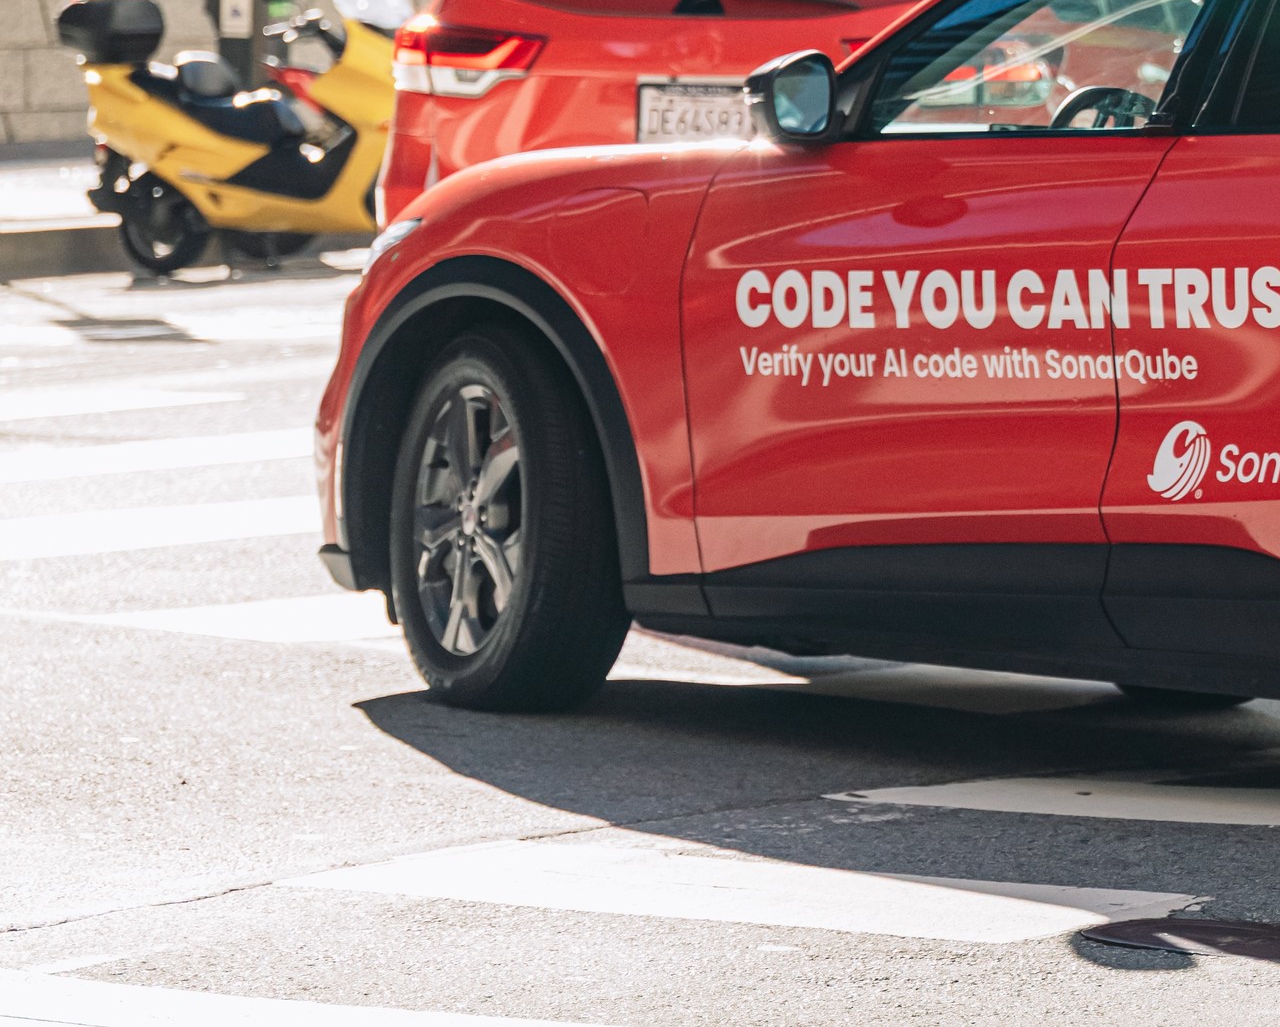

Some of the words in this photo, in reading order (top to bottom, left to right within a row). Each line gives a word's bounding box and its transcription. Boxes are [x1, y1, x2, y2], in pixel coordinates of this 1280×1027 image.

[736, 269, 876, 328] CODE
[882, 269, 997, 329] YOU
[1007, 269, 1130, 329] CAN
[740, 344, 813, 386] Verify
[818, 352, 876, 386] your
[883, 348, 907, 377] AI
[913, 347, 977, 377] code
[983, 346, 1040, 378] with
[1045, 348, 1198, 383] SonarQube
